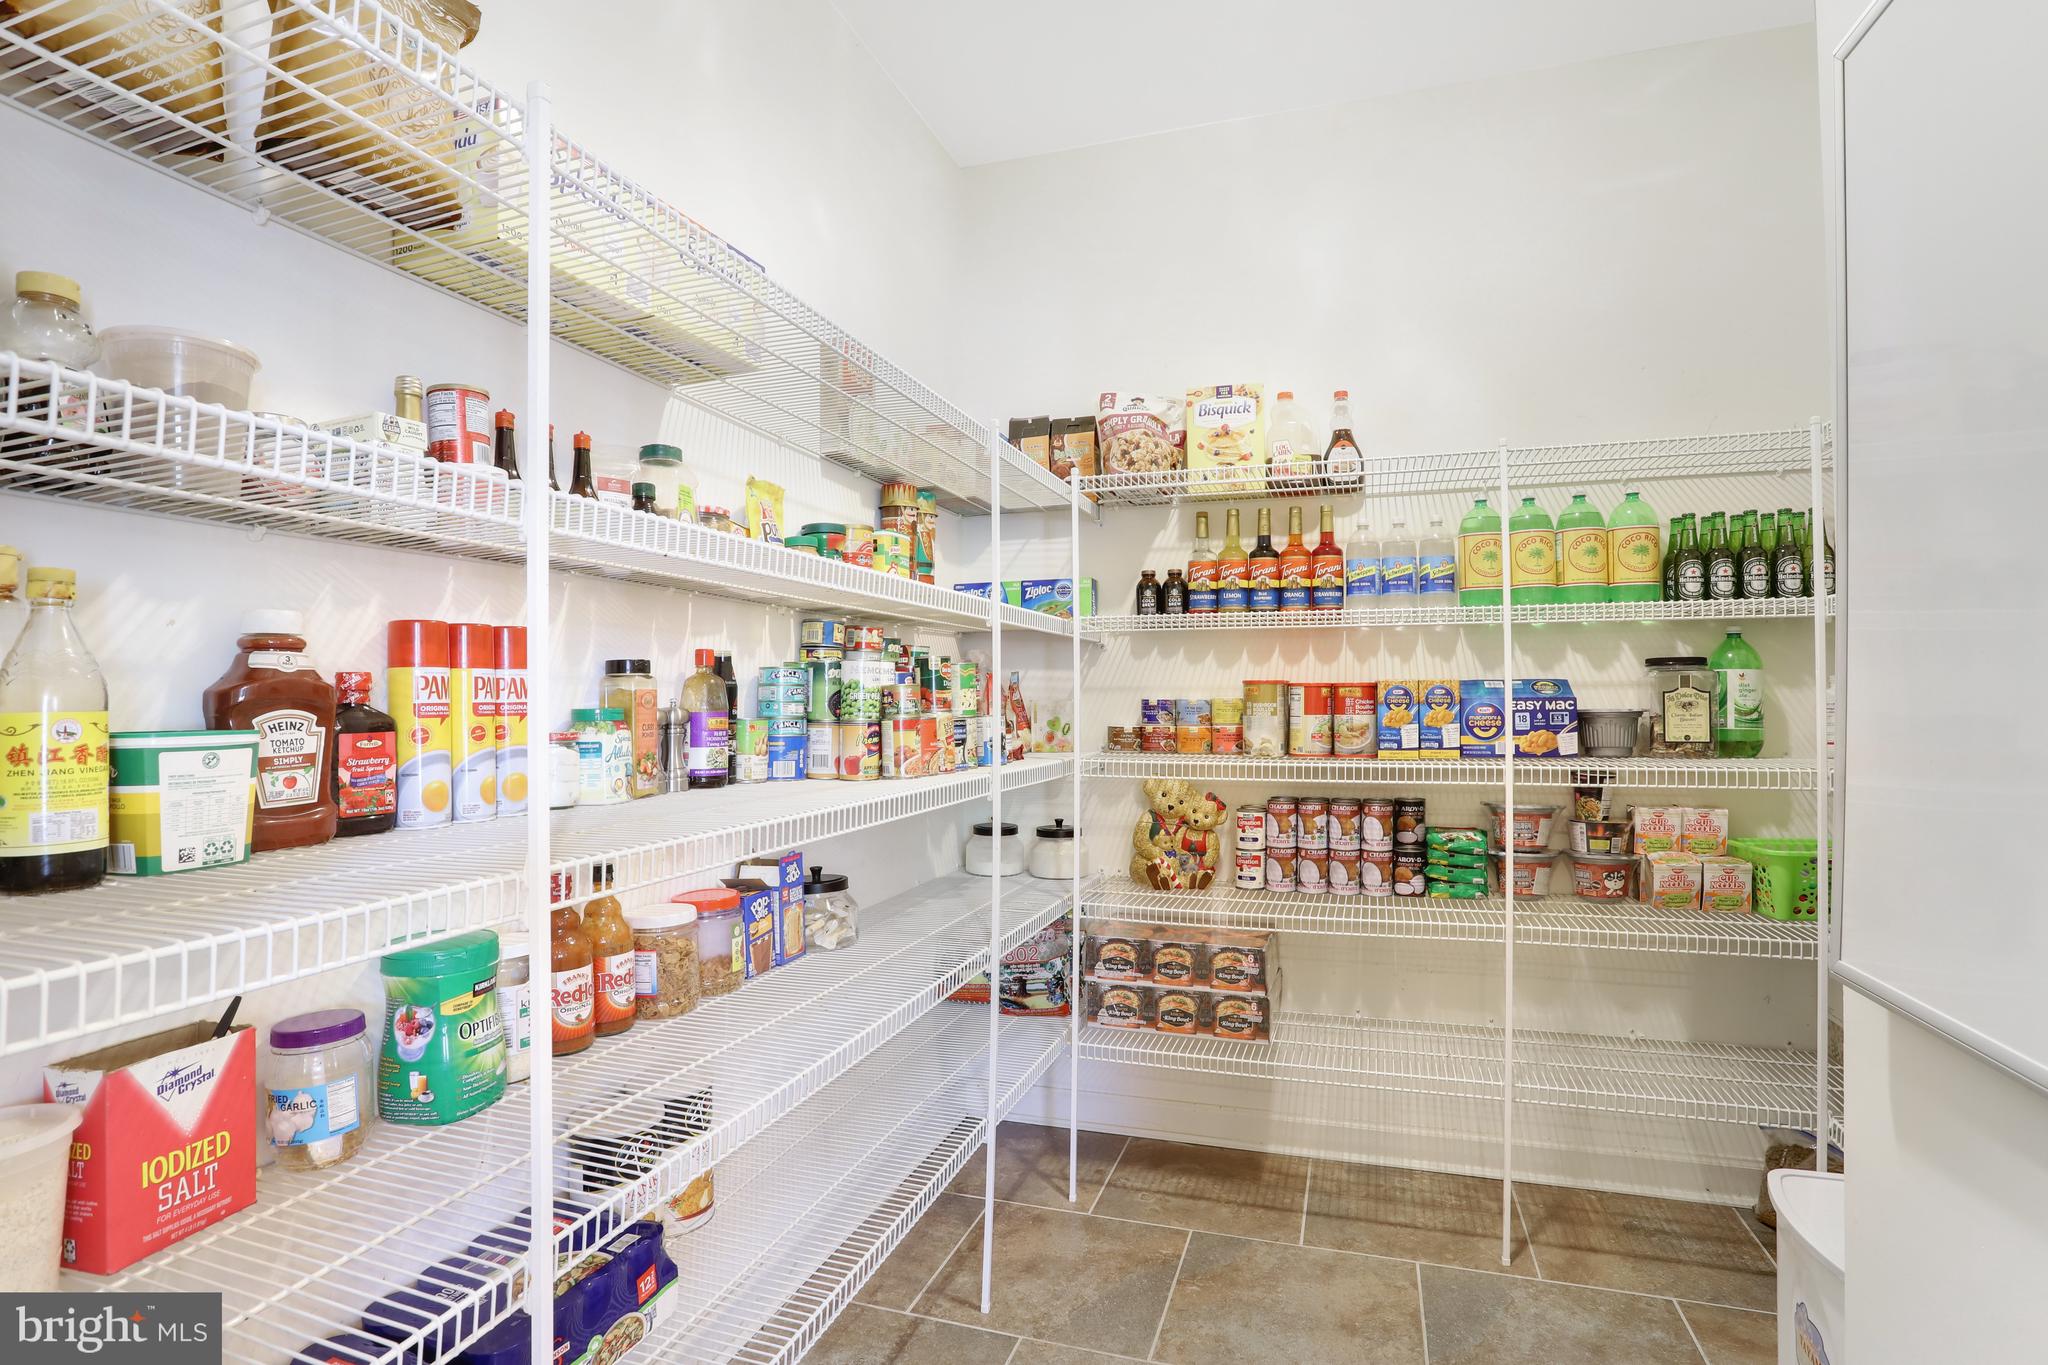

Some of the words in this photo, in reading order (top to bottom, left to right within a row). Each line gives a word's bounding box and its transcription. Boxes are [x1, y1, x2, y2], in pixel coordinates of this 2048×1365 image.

[1106, 394, 1112, 402] 2
[1198, 402, 1251, 419] Bisquick
[1472, 541, 1491, 555] COCO
[1493, 539, 1502, 549] RI
[1518, 538, 1537, 553] COCO
[1539, 538, 1553, 552] RICO
[1572, 536, 1591, 550] COCO
[1621, 535, 1642, 550] COCO
[1644, 534, 1658, 549] RICO
[1190, 565, 1216, 582] Torani
[1218, 564, 1246, 581] Torani
[1249, 563, 1278, 580] Torani
[1280, 562, 1308, 580] Torani
[1313, 560, 1342, 578] Torani
[1025, 584, 1052, 600] Ziploc
[1283, 591, 1305, 599] ORANGE
[1518, 715, 1527, 723] 18
[268, 721, 304, 734] HEINZ
[270, 738, 305, 748] TOMATO
[272, 745, 304, 754] KETCHUP
[273, 756, 303, 766] SIMPLY
[347, 757, 390, 767] Strawberry
[7, 768, 35, 777] ZHEN
[365, 765, 384, 773] Spread
[1640, 823, 1676, 832] NOODLES
[1685, 824, 1721, 832] NOODLES
[1660, 880, 1695, 888] NOODLES
[1710, 880, 1746, 889] NOODLES
[1247, 954, 1254, 963] 6
[1251, 1003, 1257, 1011] 6
[157, 1065, 203, 1096] Diamond
[178, 1069, 215, 1095] Crystal
[268, 1094, 289, 1104] FRIED
[280, 1100, 317, 1111] GARLIC
[142, 1130, 231, 1189] IODIZED
[158, 1162, 219, 1212] SALT
[156, 1212, 172, 1224] FOR
[173, 1197, 206, 1218] EVERYDAY
[208, 1190, 221, 1201] USE
[639, 1276, 652, 1293] 12
